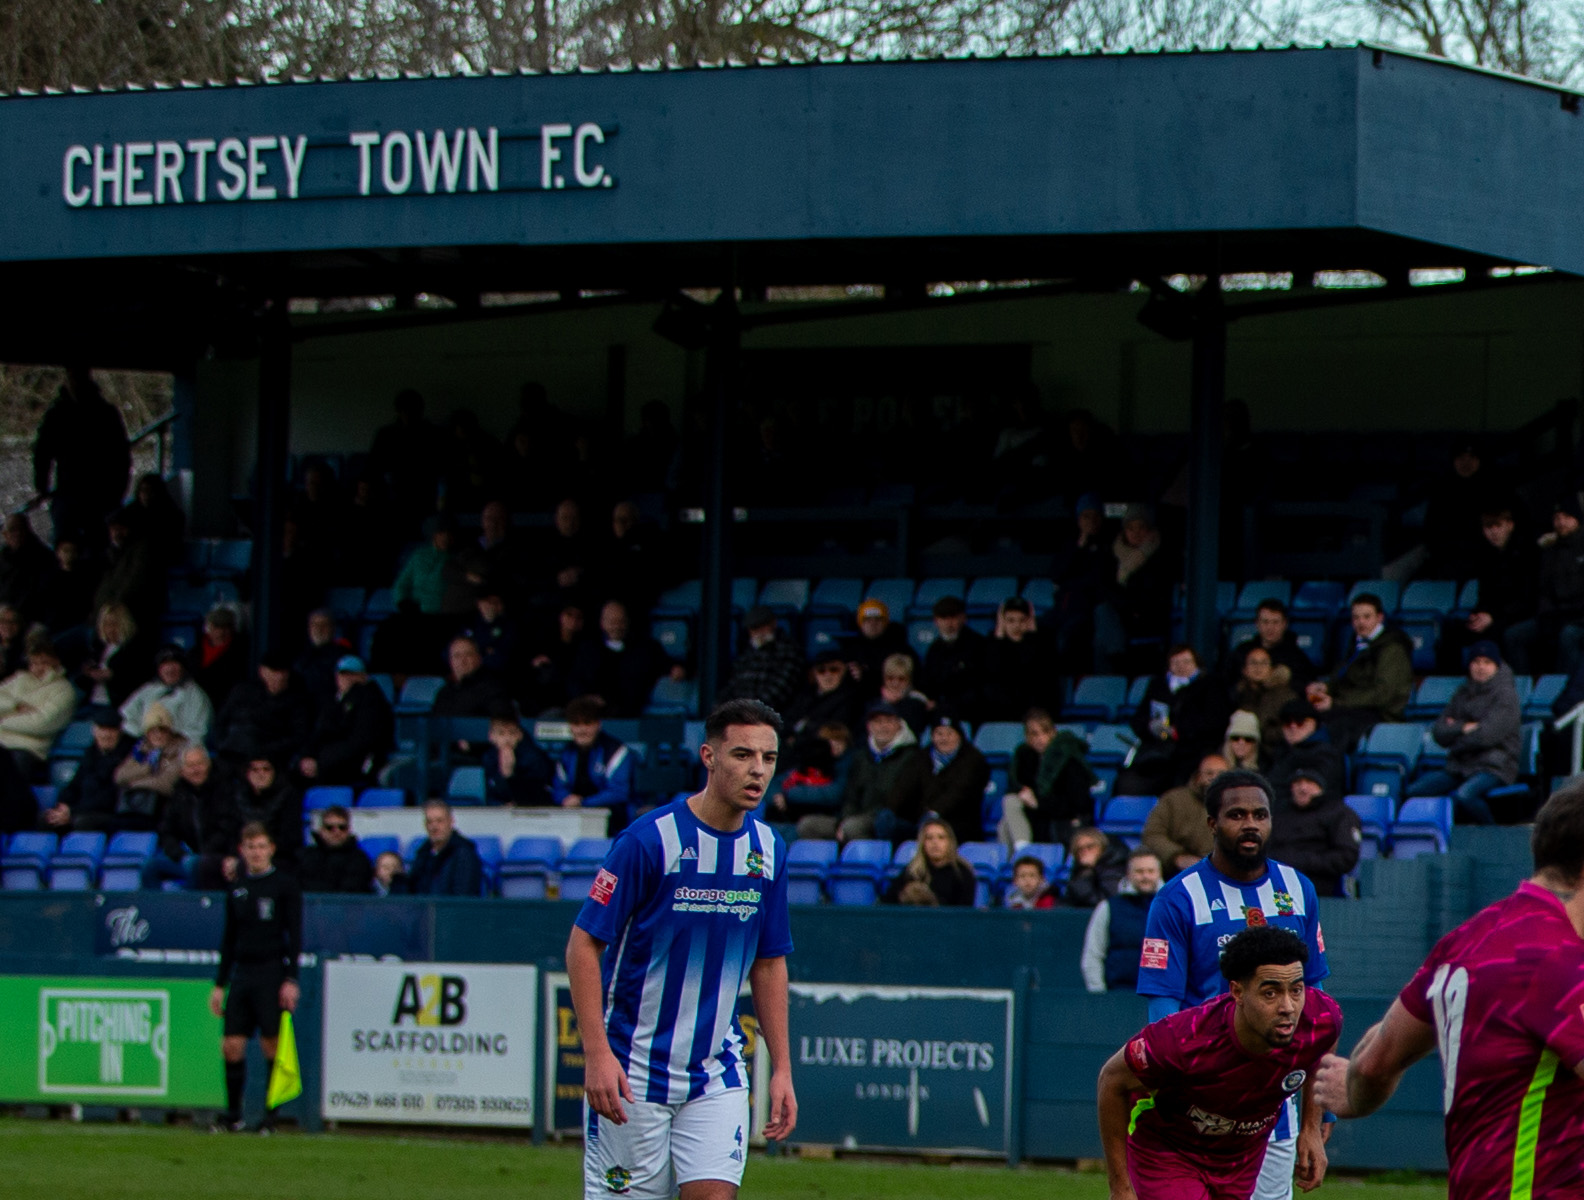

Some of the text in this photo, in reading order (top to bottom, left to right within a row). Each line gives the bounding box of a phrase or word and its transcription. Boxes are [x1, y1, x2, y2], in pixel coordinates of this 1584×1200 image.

[63, 123, 613, 207] CHERTSEY TOWN F.C.
[674, 885, 762, 903] storagegeeks
[104, 905, 150, 947] The
[391, 972, 469, 1027] A2B
[57, 1000, 152, 1044] PITCHING
[351, 1028, 509, 1056] SCAFFOLDING
[1425, 962, 1469, 1115] 19
[100, 1041, 124, 1083] IN
[800, 1036, 995, 1072] LUXE PROJECTS
